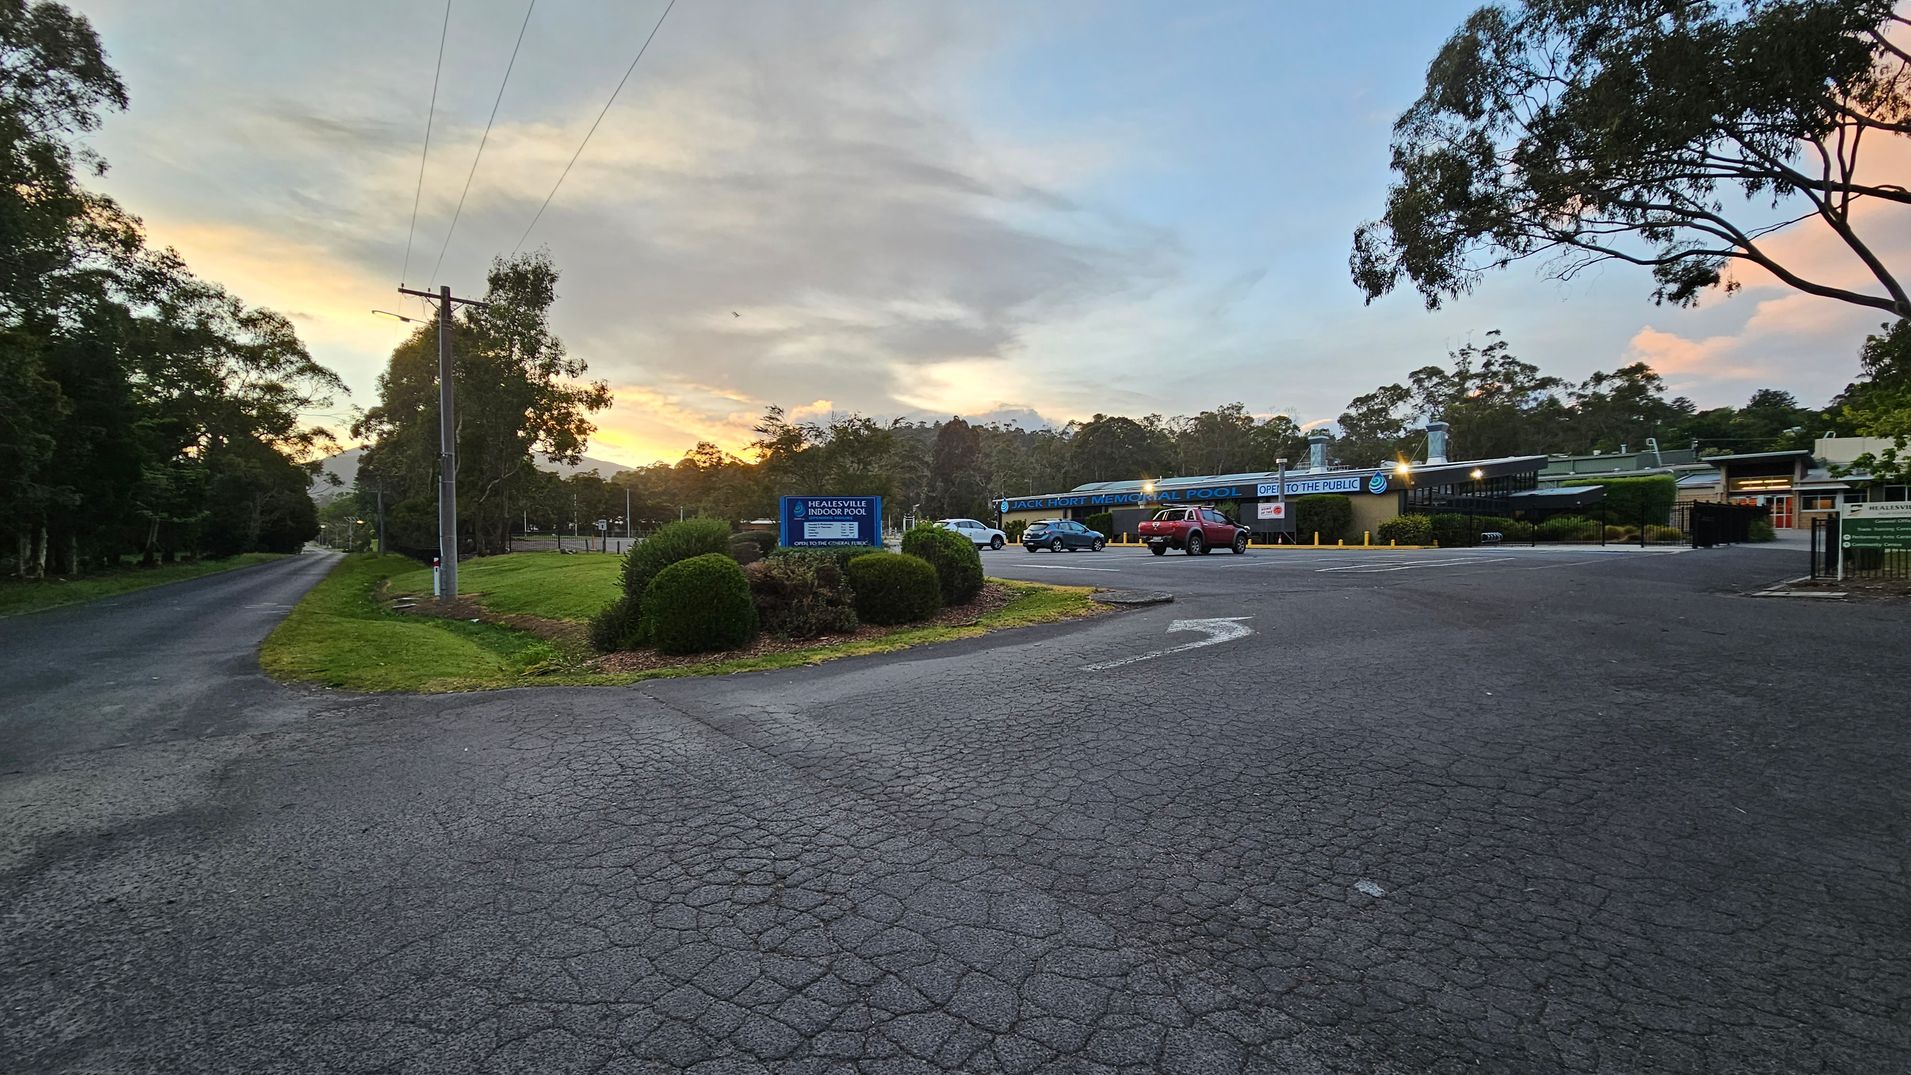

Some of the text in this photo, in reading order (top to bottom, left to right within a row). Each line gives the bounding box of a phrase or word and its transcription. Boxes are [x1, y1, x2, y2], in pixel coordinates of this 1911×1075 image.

[1286, 483, 1299, 492] TO
[1301, 481, 1320, 491] THE
[1322, 479, 1358, 491] PUBLIC
[1011, 487, 1242, 509] JACK HORT MEMORIAL POOL
